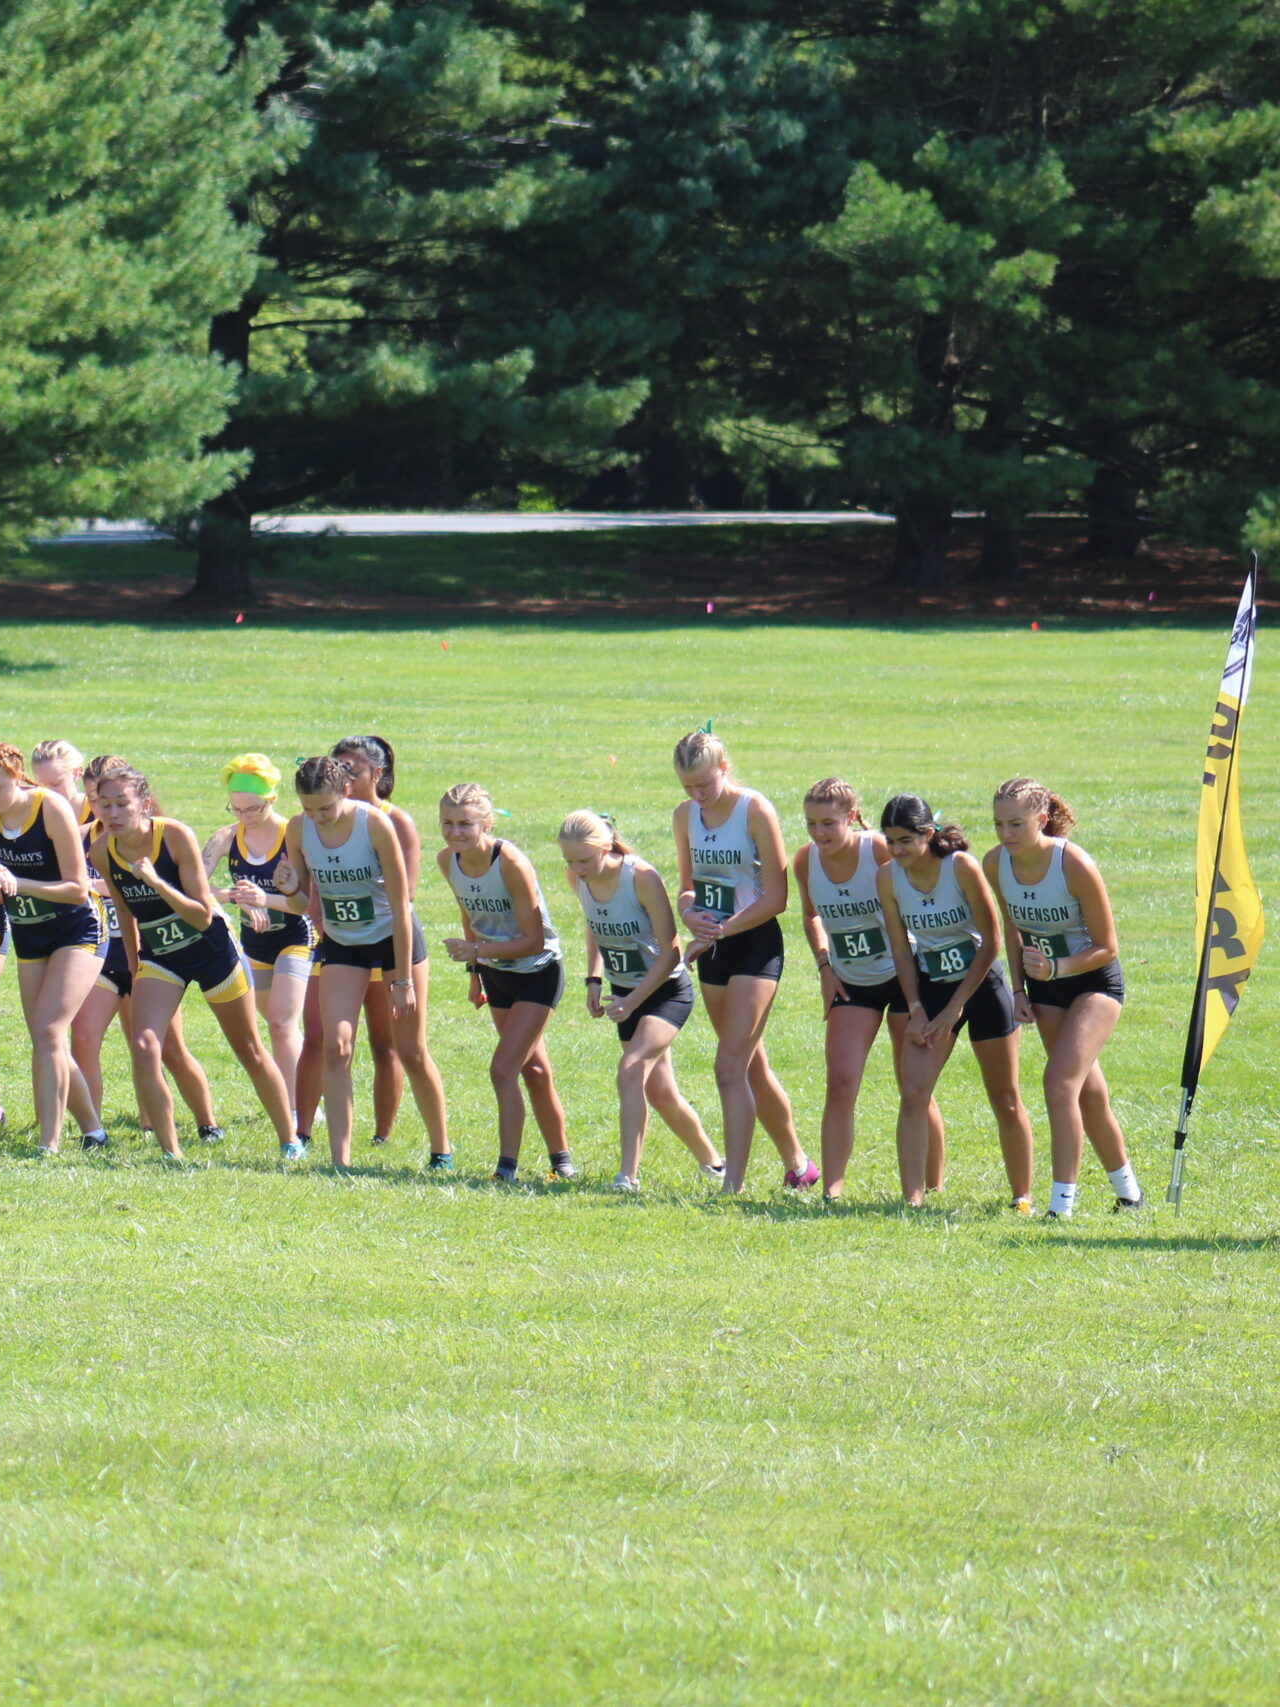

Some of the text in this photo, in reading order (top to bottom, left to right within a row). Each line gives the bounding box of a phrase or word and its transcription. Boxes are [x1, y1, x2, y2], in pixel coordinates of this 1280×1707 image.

[3, 848, 43, 862] MARY'S
[690, 847, 742, 865] EVENSON
[312, 865, 373, 883] TEVENSON
[15, 895, 38, 917] 31
[704, 884, 723, 910] 51
[334, 900, 360, 921] 53
[902, 905, 968, 930] TEVENSON
[1008, 903, 1070, 922] TEVENSON
[156, 921, 184, 946] 24
[587, 919, 641, 937] EVENSON
[844, 933, 870, 957] 54
[1030, 934, 1054, 958] 56
[607, 950, 628, 972] 57
[940, 947, 965, 974] 48
